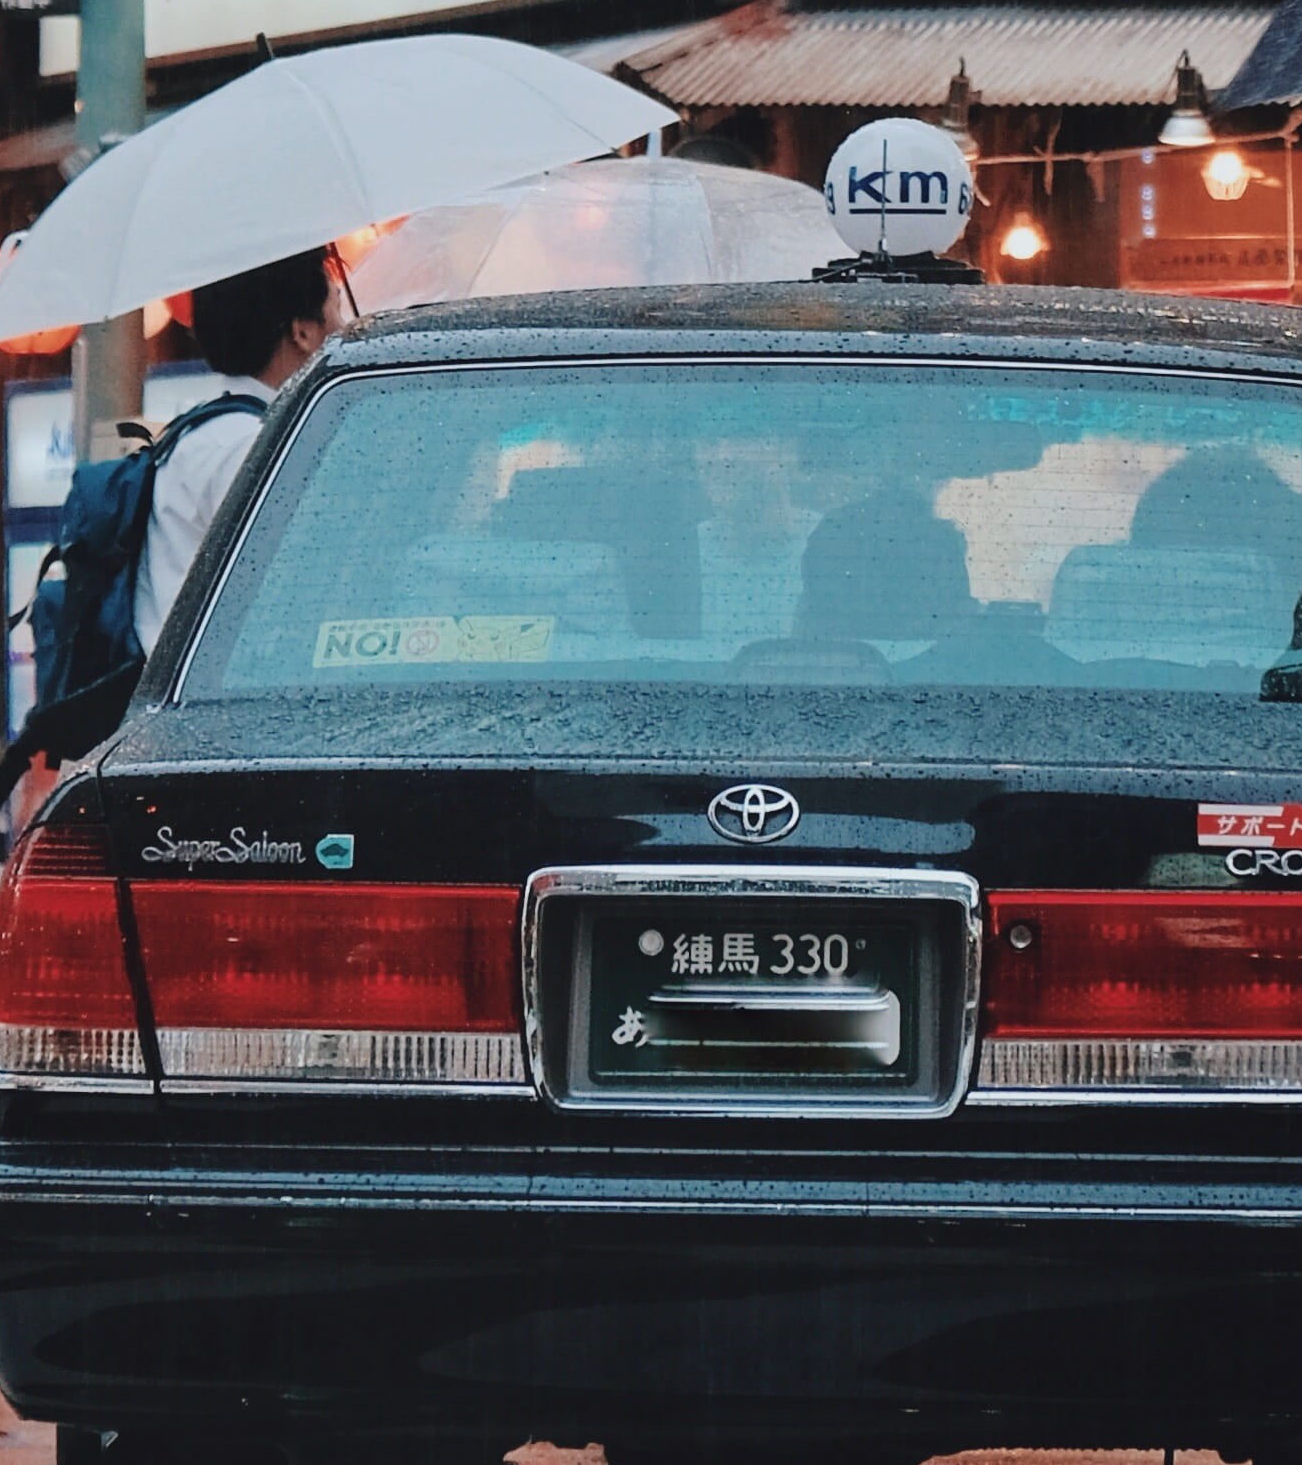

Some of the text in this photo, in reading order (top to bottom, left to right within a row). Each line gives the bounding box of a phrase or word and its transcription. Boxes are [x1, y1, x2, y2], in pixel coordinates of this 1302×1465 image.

[848, 166, 948, 205] km
[323, 630, 402, 659] NO!
[215, 826, 306, 864] Saloon
[670, 933, 849, 975] 練馬 330
